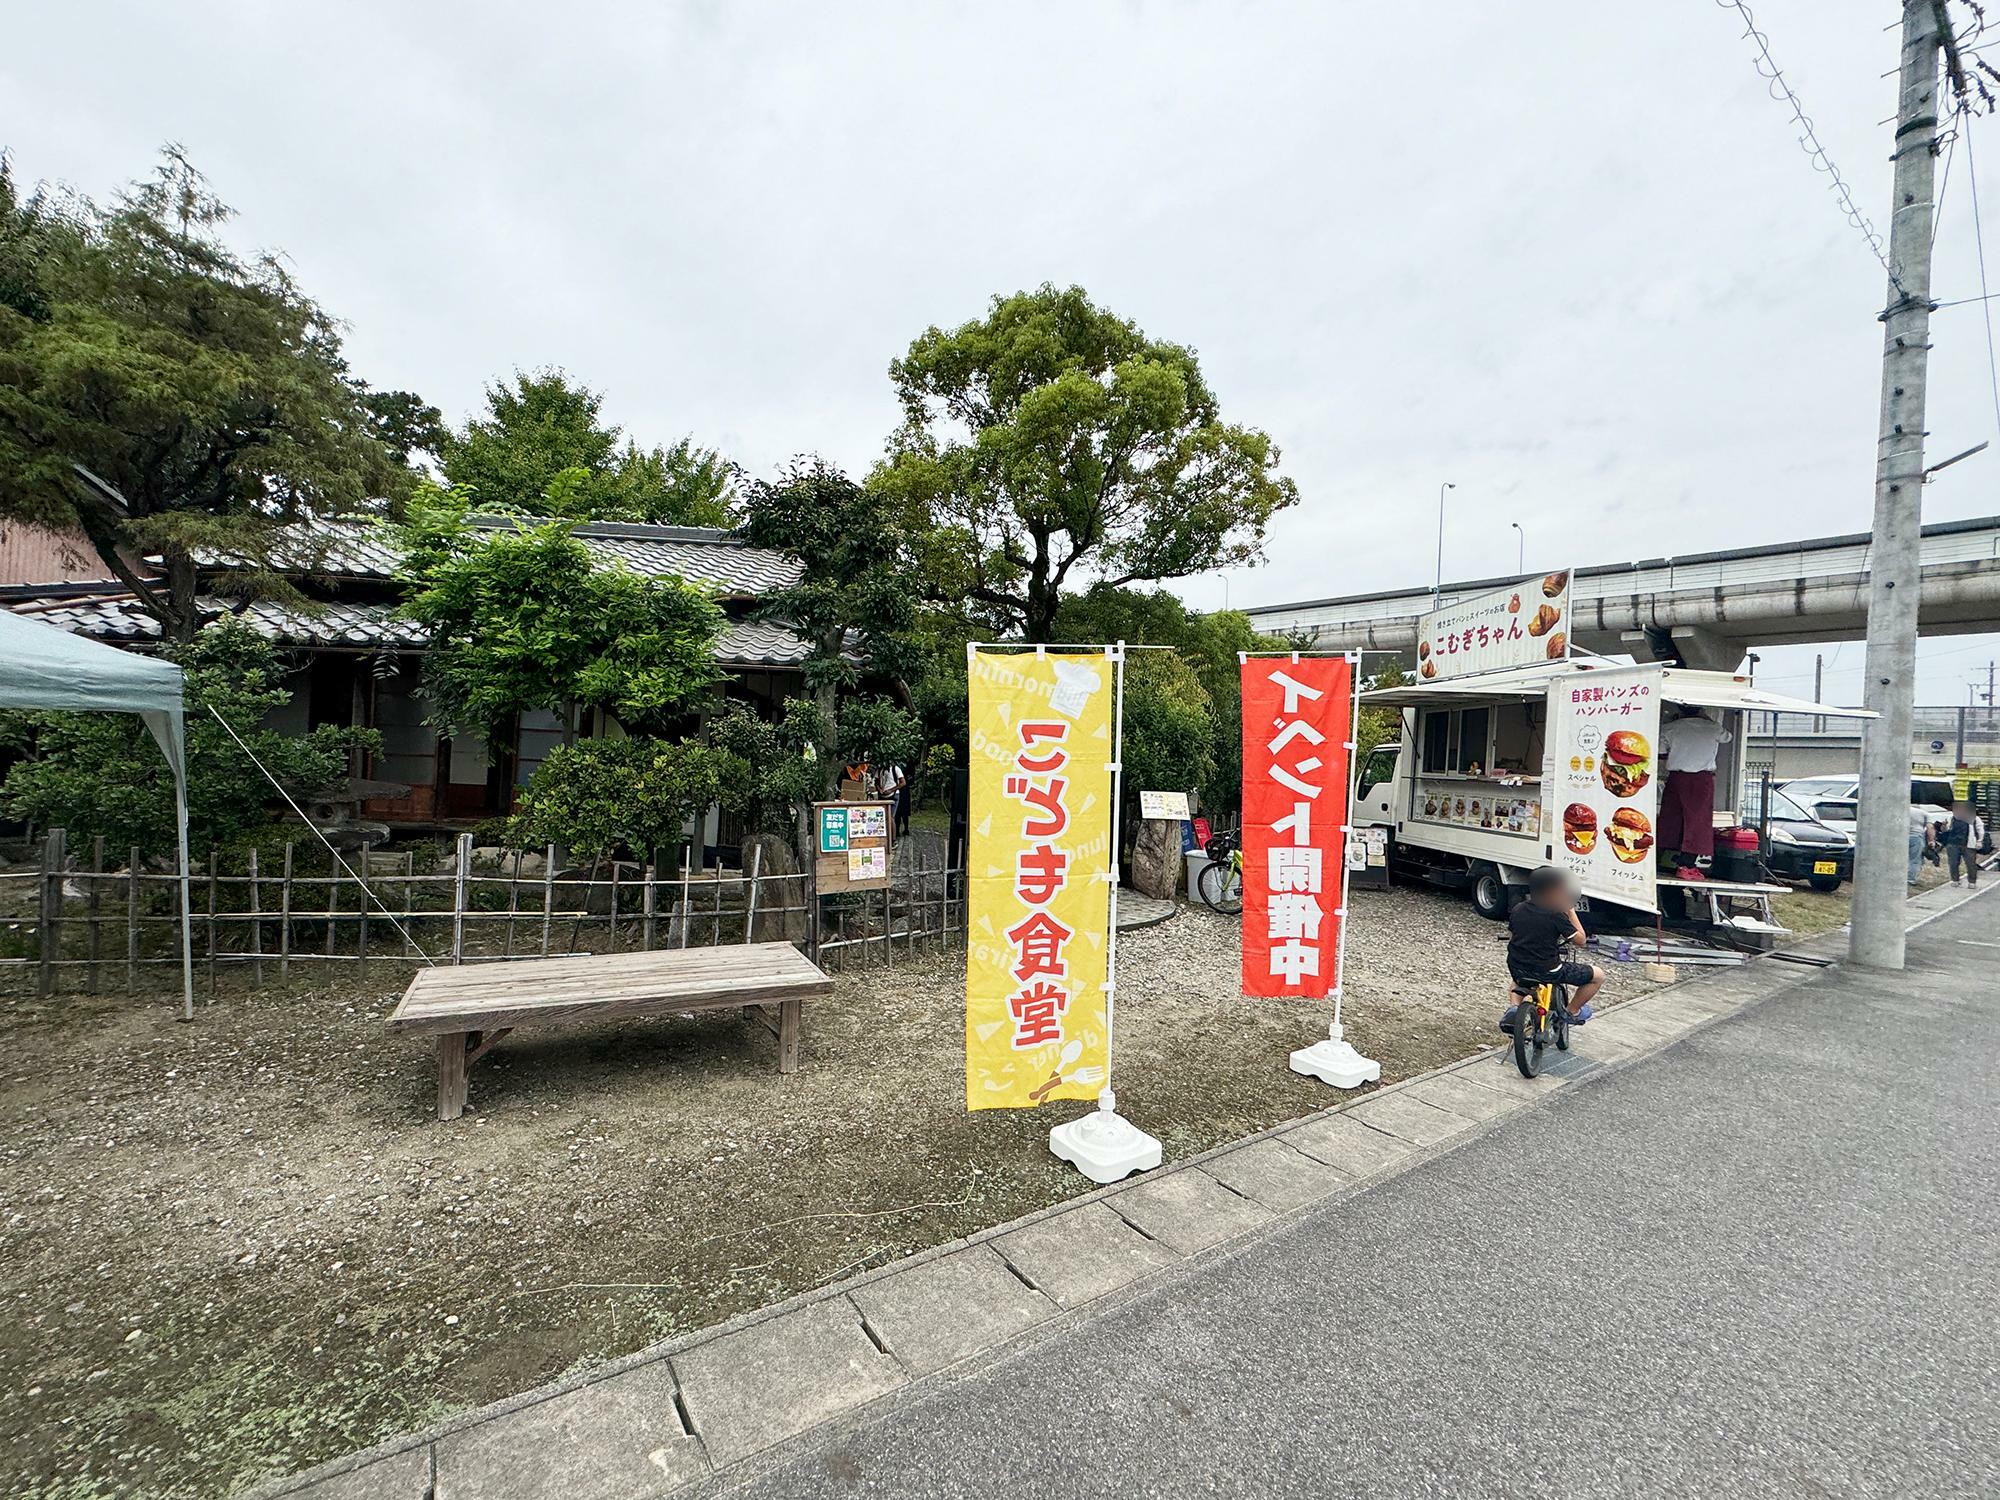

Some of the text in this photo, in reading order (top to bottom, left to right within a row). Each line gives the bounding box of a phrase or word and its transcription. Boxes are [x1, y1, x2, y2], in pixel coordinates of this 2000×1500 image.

[1436, 617, 1523, 656] こむぎちゃん
[1571, 684, 1649, 703] 自家製バンズの
[1576, 702, 1642, 716] ハンバーガー
[1568, 774, 1596, 782] スペシャル
[1563, 856, 1593, 865] ハッシュド
[1611, 869, 1644, 881] フィッシュ
